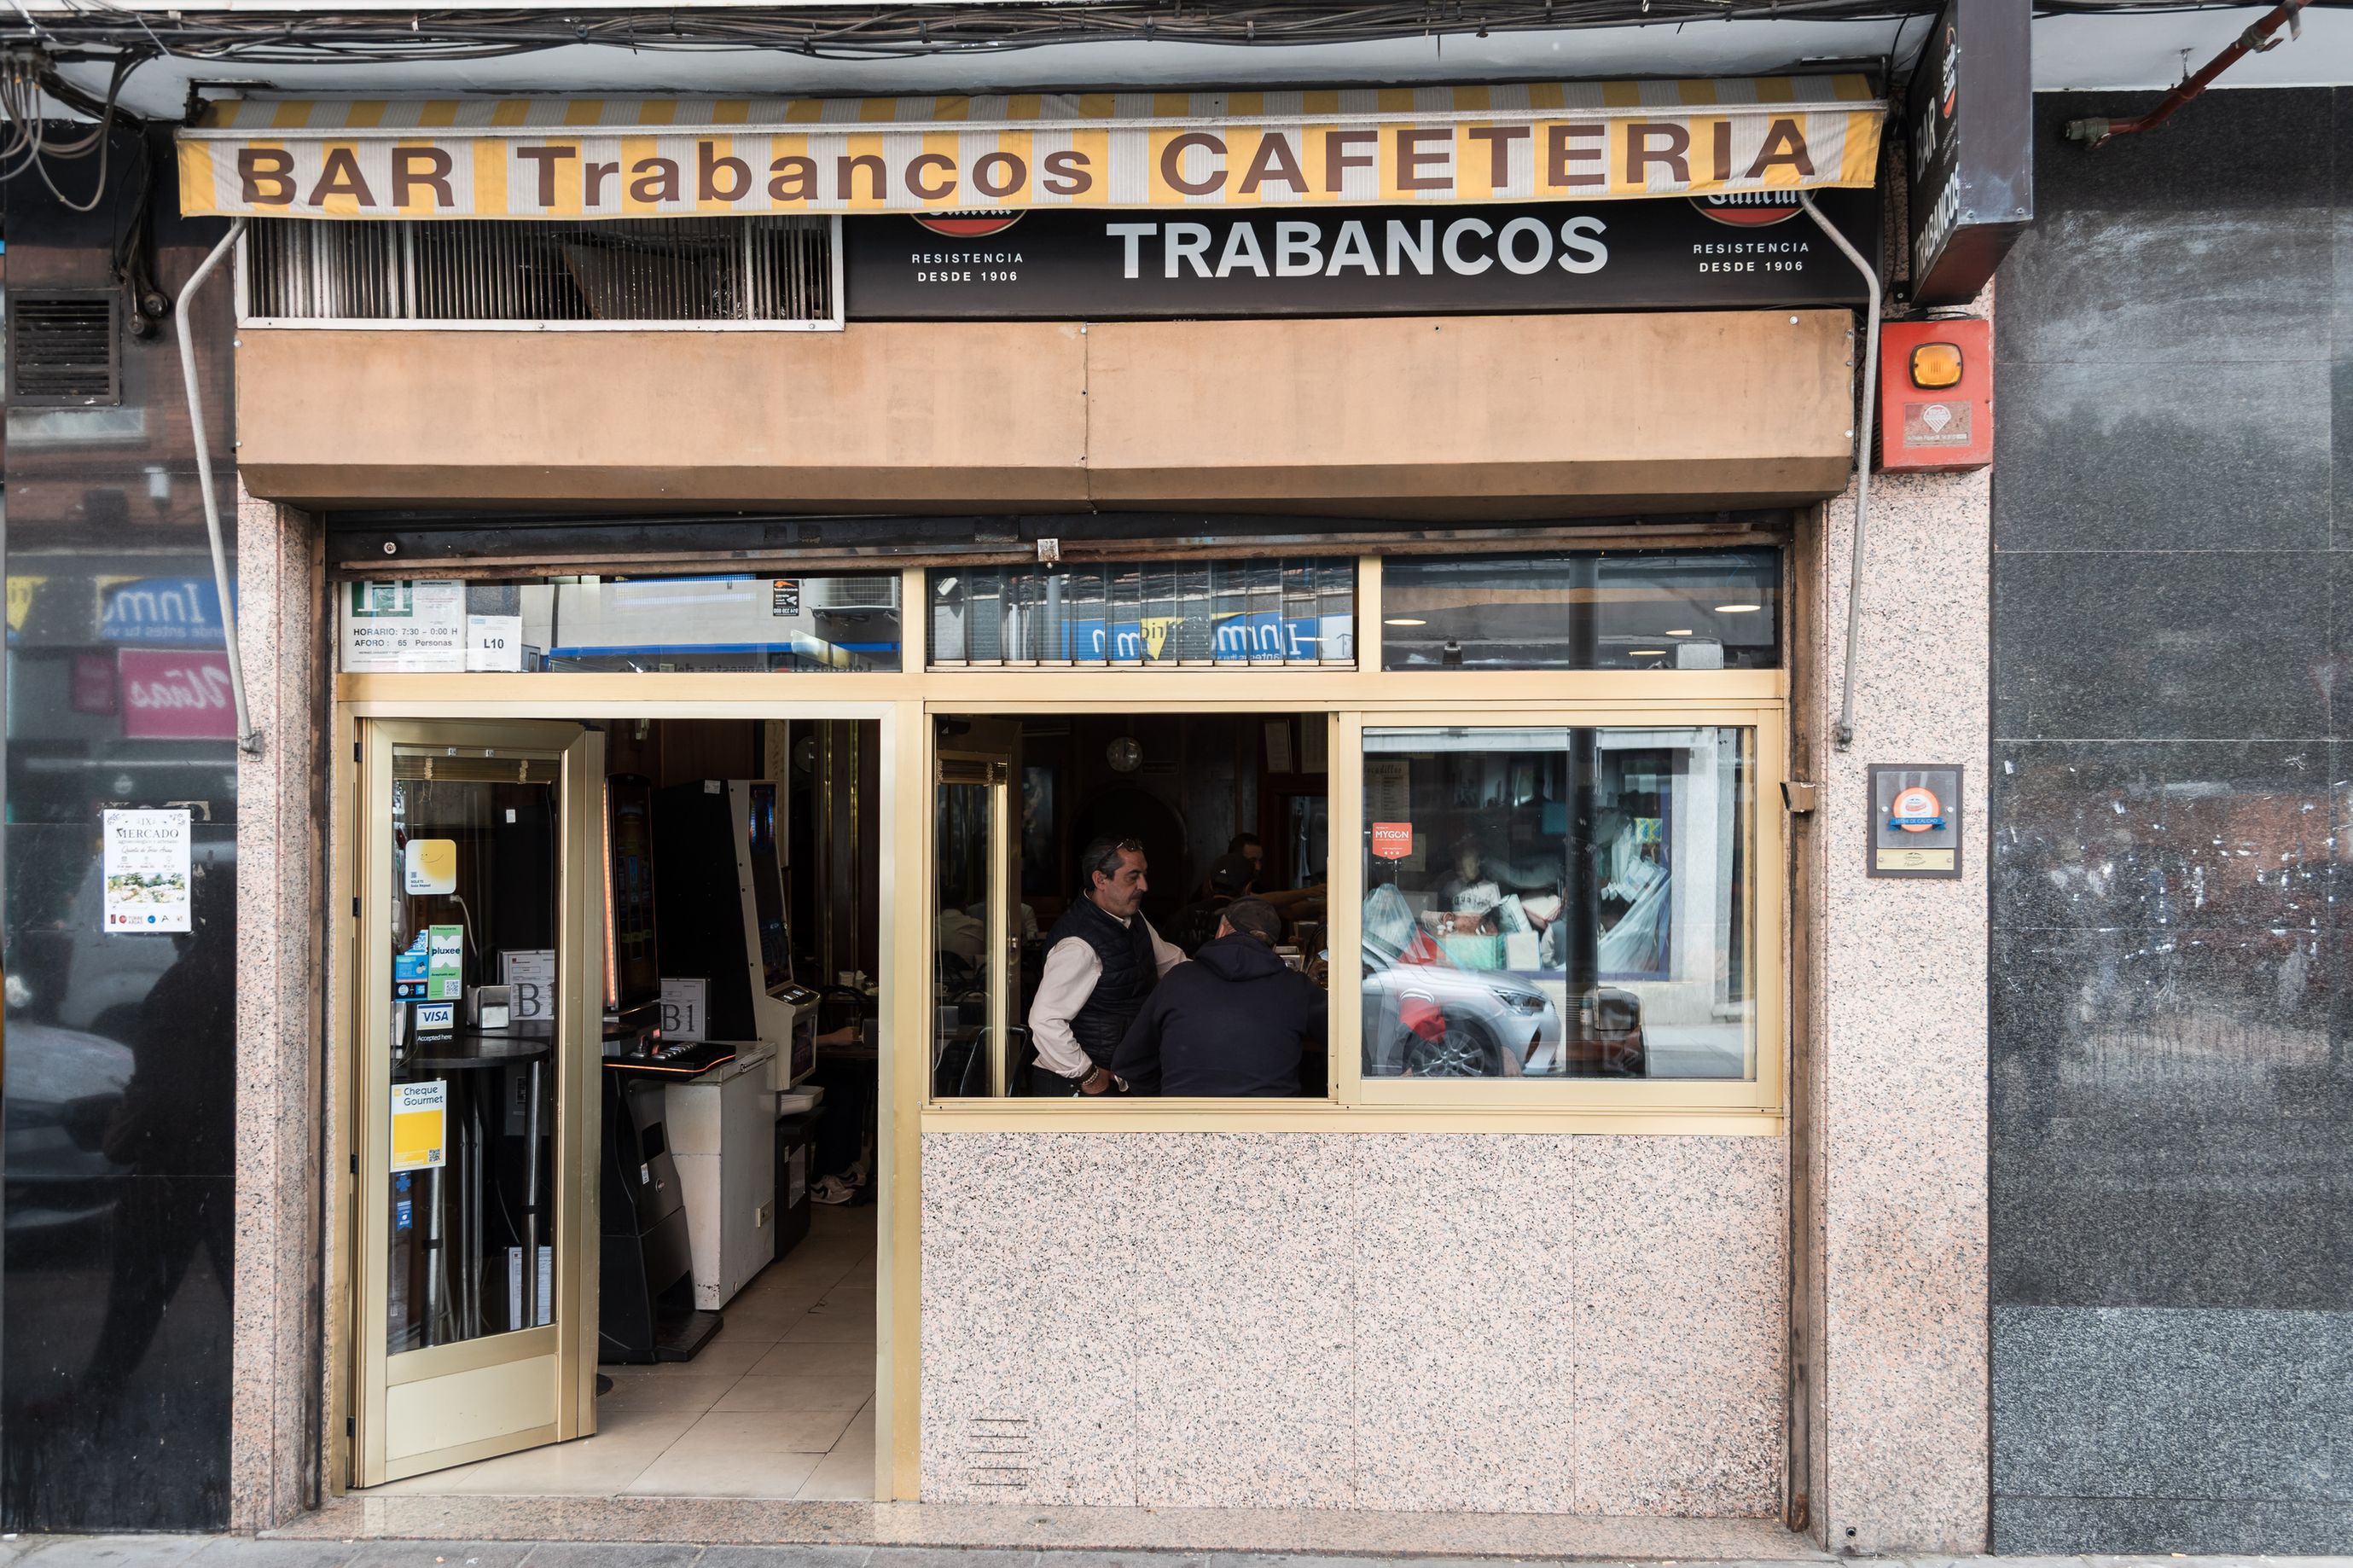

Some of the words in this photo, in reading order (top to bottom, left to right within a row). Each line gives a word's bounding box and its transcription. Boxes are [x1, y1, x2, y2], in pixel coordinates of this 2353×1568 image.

[1916, 96, 1937, 185] BAR
[237, 147, 456, 207] BAR
[516, 141, 1094, 206] Trabancos
[1159, 119, 1816, 196] CAFETERIA
[1914, 162, 1960, 281] TRABANCOS
[1106, 215, 1608, 279] TRABANCOS
[1693, 242, 1810, 254] RESISTENCIA
[911, 253, 1024, 264] RESISTENCIA
[1699, 262, 1755, 272] DESDE
[1765, 261, 1803, 271] 1906
[917, 271, 972, 282] DESDE
[980, 271, 1018, 282] 1906
[484, 638, 504, 649] L10
[116, 828, 179, 839] MERCADO
[1375, 830, 1409, 839] MYGON
[431, 946, 461, 956] pluxee
[422, 1010, 449, 1022] VISA
[660, 1003, 695, 1032] B1
[417, 1033, 441, 1042] Accepted
[404, 1086, 439, 1096] Cheque
[404, 1095, 444, 1106] Gourmet
